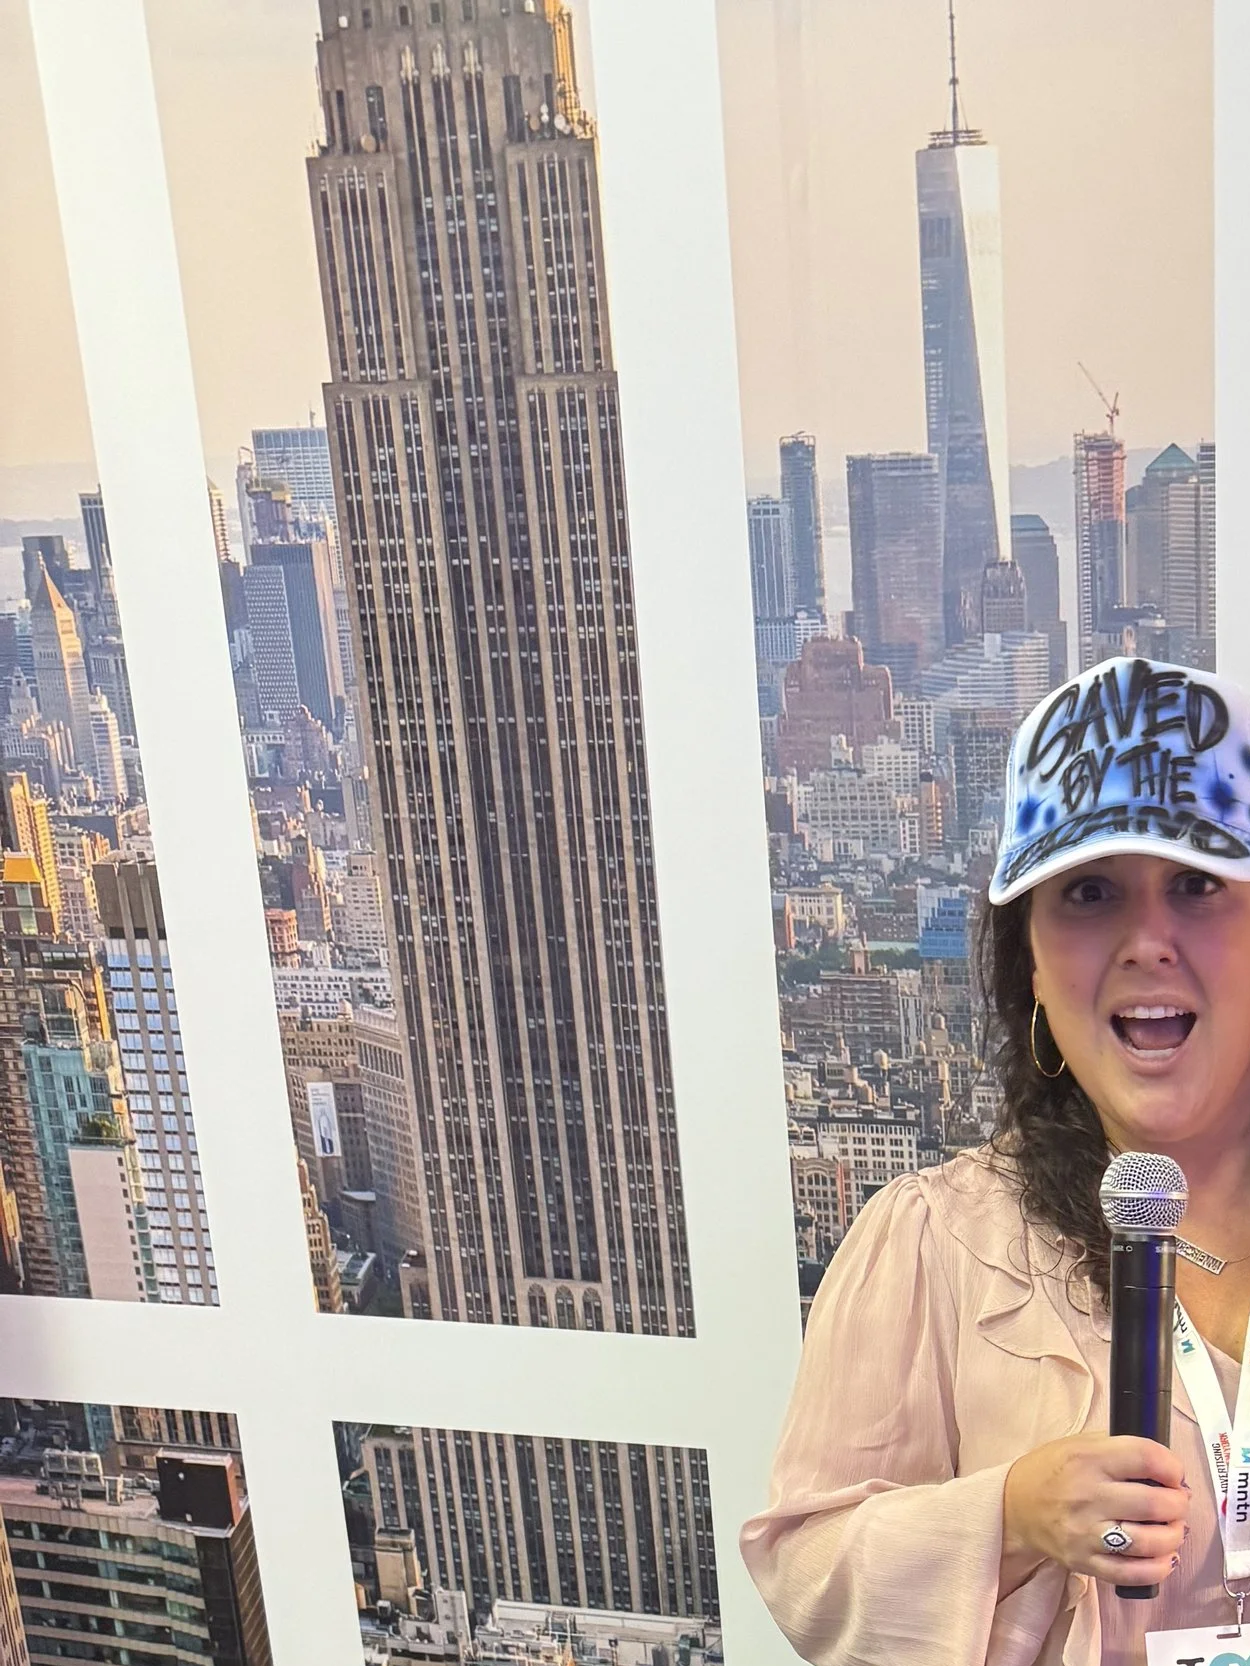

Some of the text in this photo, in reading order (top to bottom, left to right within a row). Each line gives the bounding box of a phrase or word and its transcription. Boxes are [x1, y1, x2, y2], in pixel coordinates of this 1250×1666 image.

[1026, 659, 1230, 783] SAVED
[1058, 740, 1198, 813] BY THE
[1236, 1472, 1250, 1522] mntn
